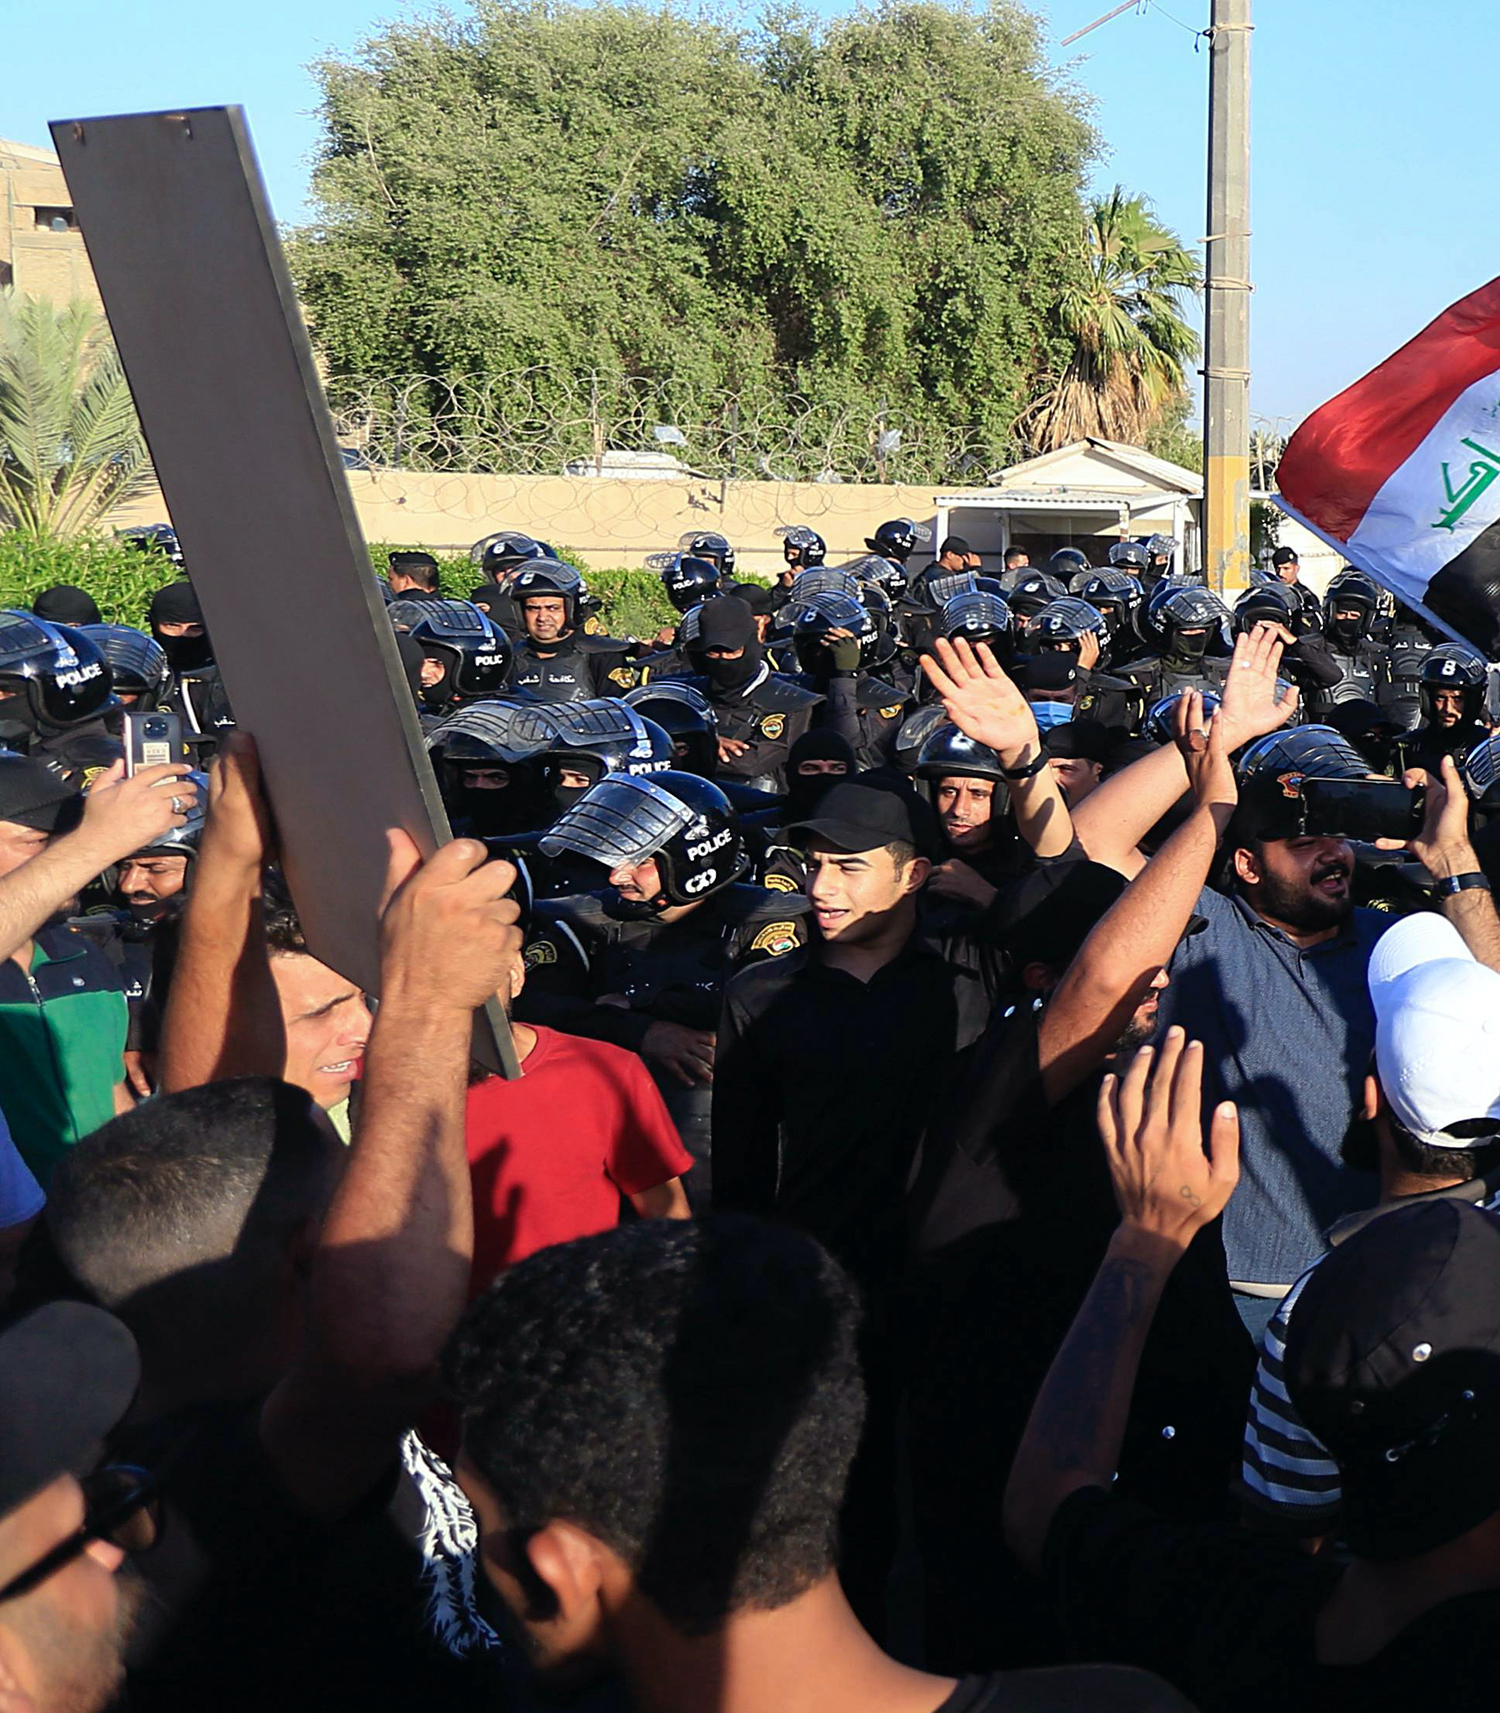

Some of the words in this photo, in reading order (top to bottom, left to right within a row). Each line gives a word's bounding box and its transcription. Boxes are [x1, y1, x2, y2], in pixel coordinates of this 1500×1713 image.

[475, 654, 503, 666] POLIC
[1442, 660, 1456, 676] 8
[56, 663, 102, 689] POLICE
[518, 674, 540, 685] شغب
[549, 674, 575, 684] مكافحة
[688, 829, 732, 861] POLICE
